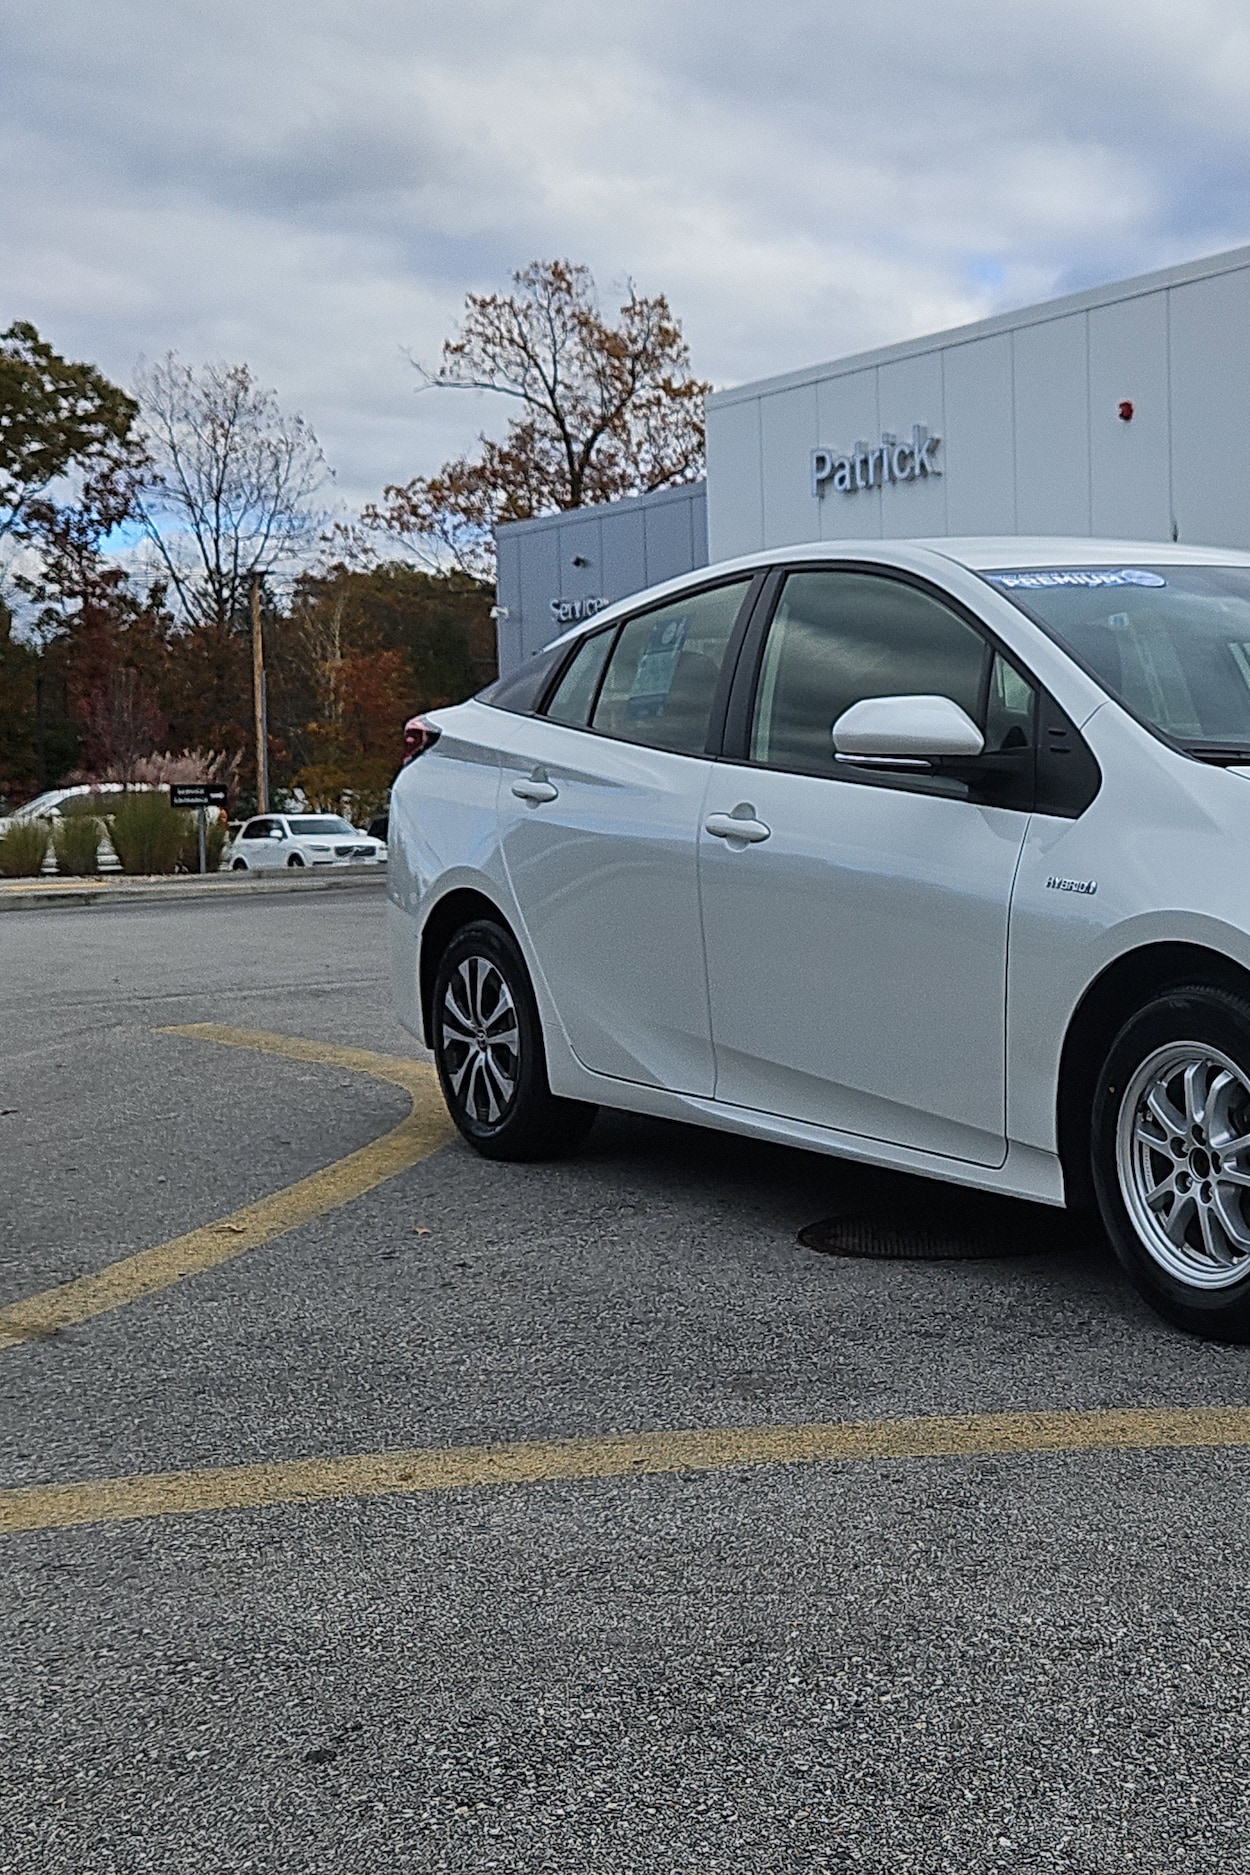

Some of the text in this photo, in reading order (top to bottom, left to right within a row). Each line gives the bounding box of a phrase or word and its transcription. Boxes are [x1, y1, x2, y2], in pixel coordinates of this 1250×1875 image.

[810, 424, 938, 498] Patrick
[1000, 574, 1124, 587] PREMIUM
[549, 597, 603, 621] Service
[1045, 876, 1088, 893] HYBRID
